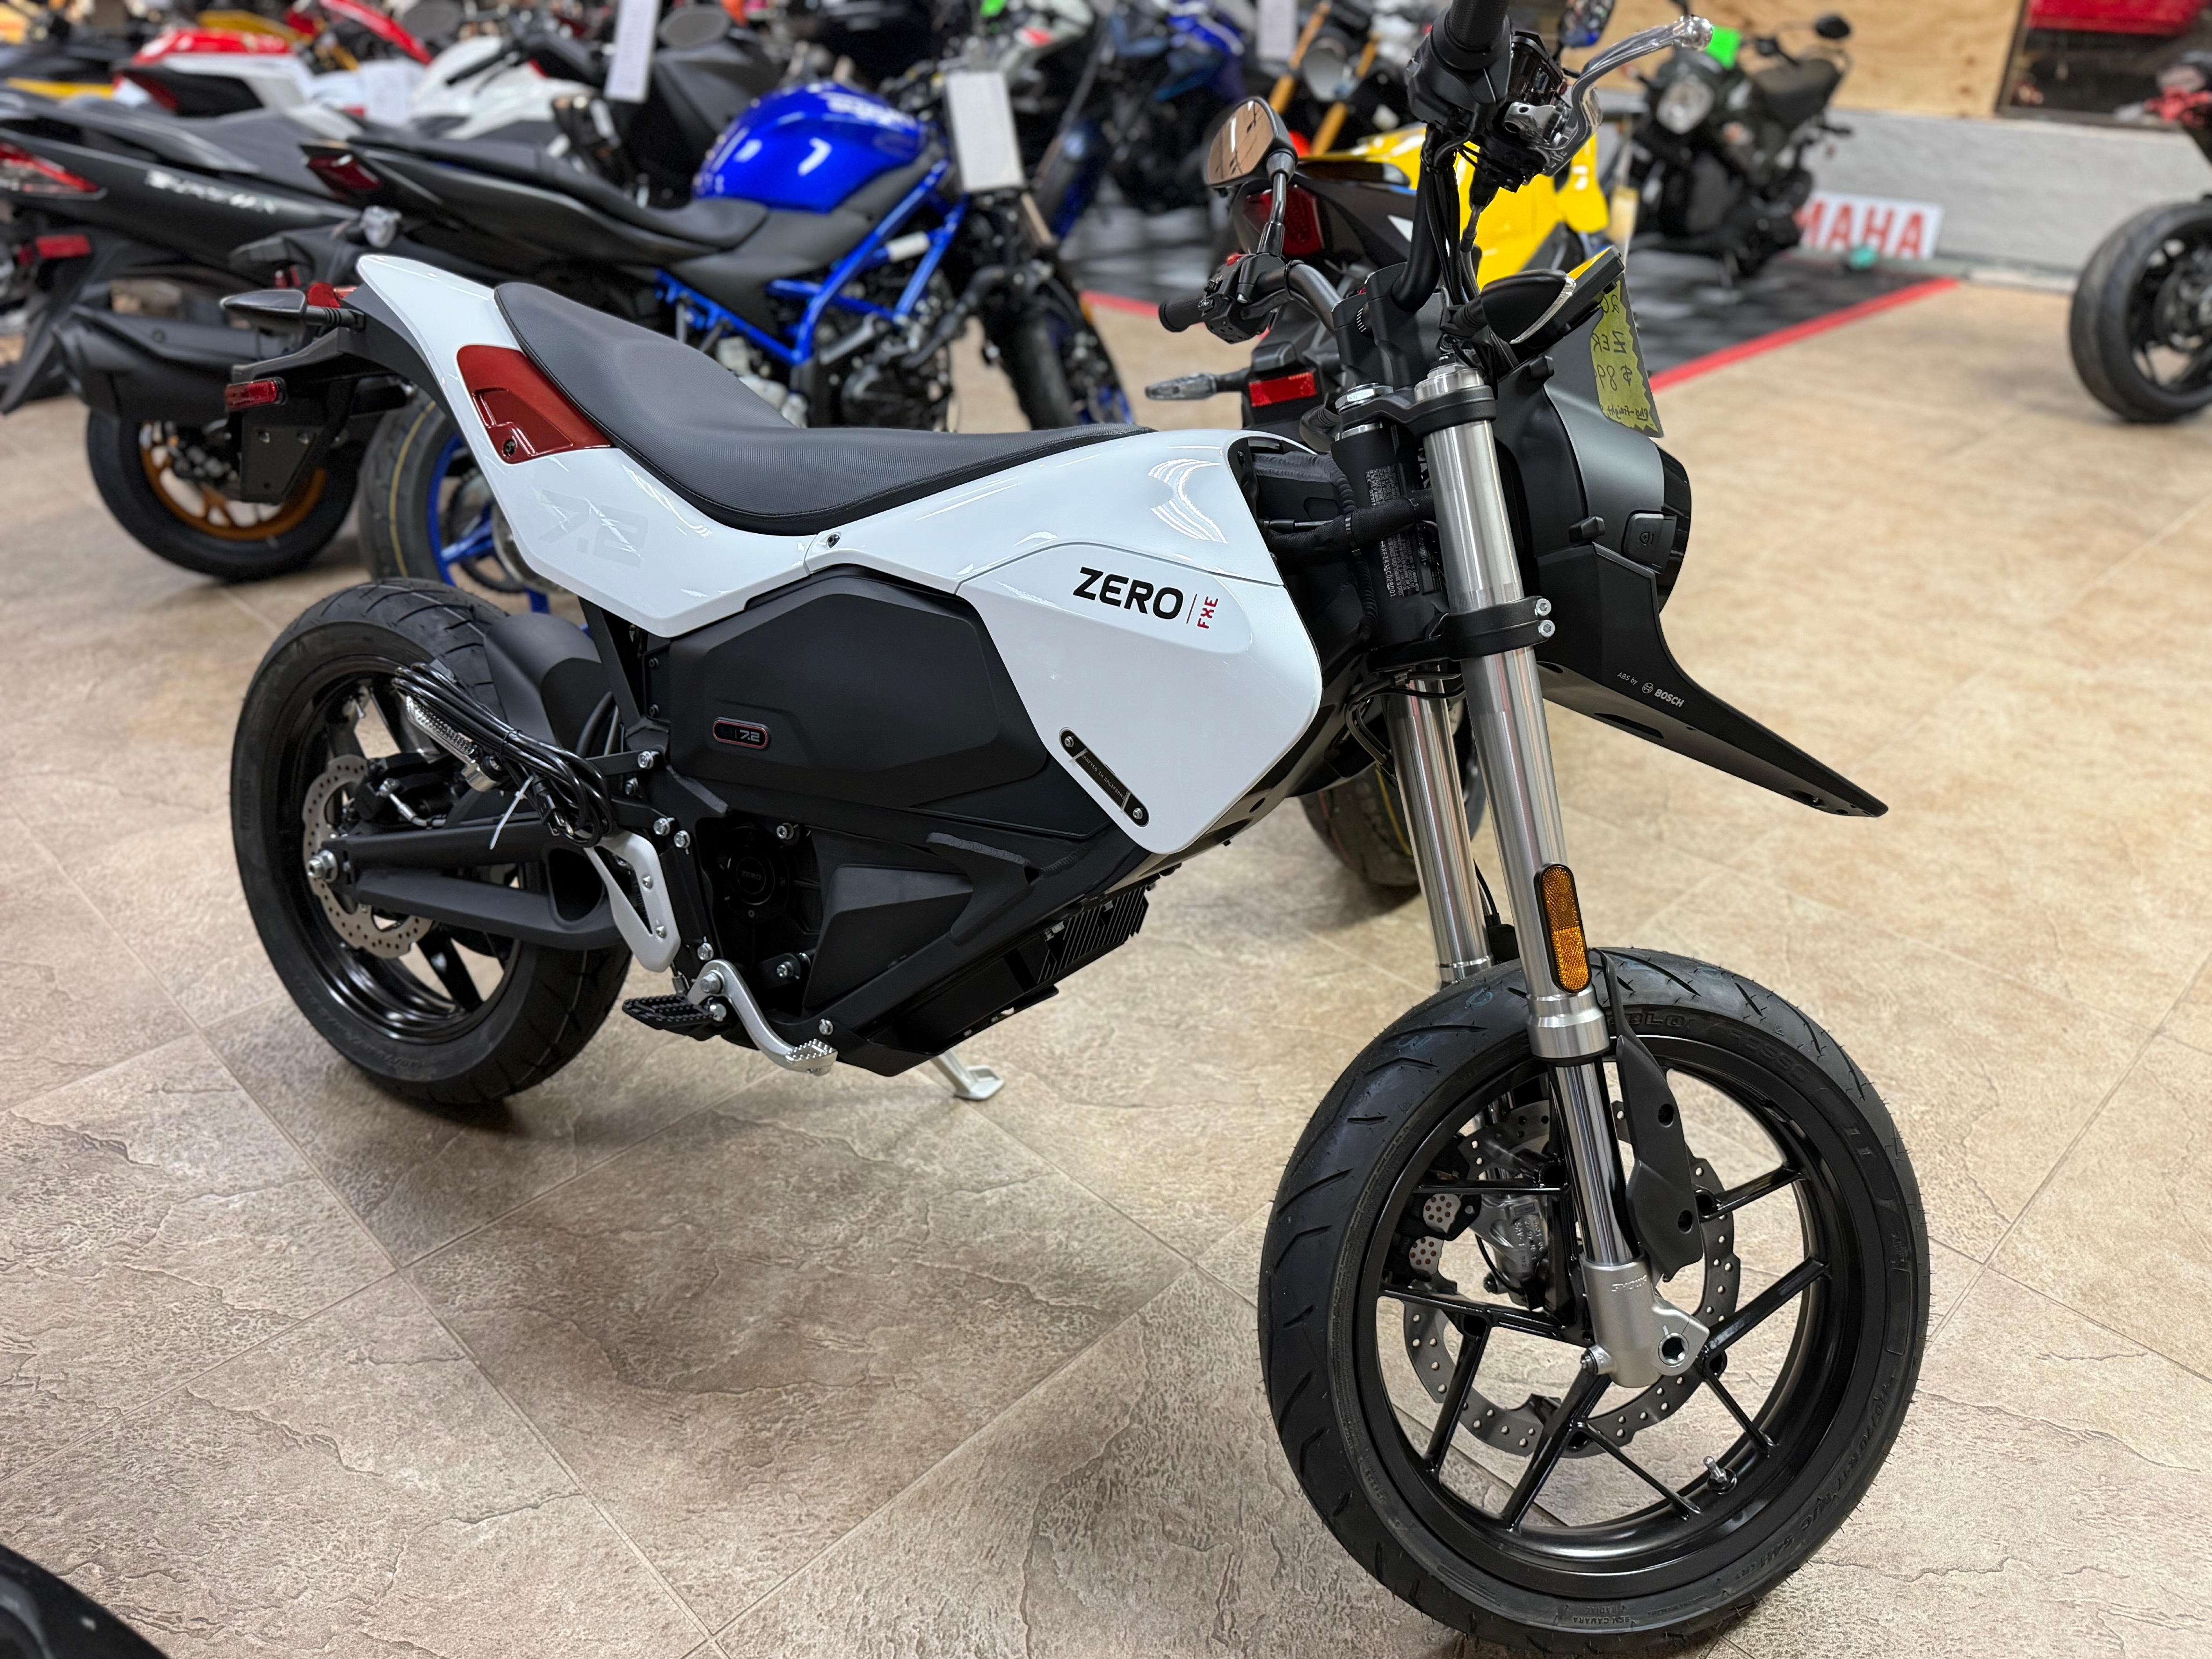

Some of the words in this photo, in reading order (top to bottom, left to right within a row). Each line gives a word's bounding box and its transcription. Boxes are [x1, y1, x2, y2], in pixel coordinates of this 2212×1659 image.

[1073, 566, 1183, 619] ZERO
[1197, 596, 1218, 629] FXE
[1617, 672, 1631, 681] ABS
[1654, 689, 1685, 707] BOSCH
[739, 729, 760, 742] 7.2
[1081, 754, 1098, 772] CRAFTED
[1104, 777, 1126, 800] CALIFORNI
